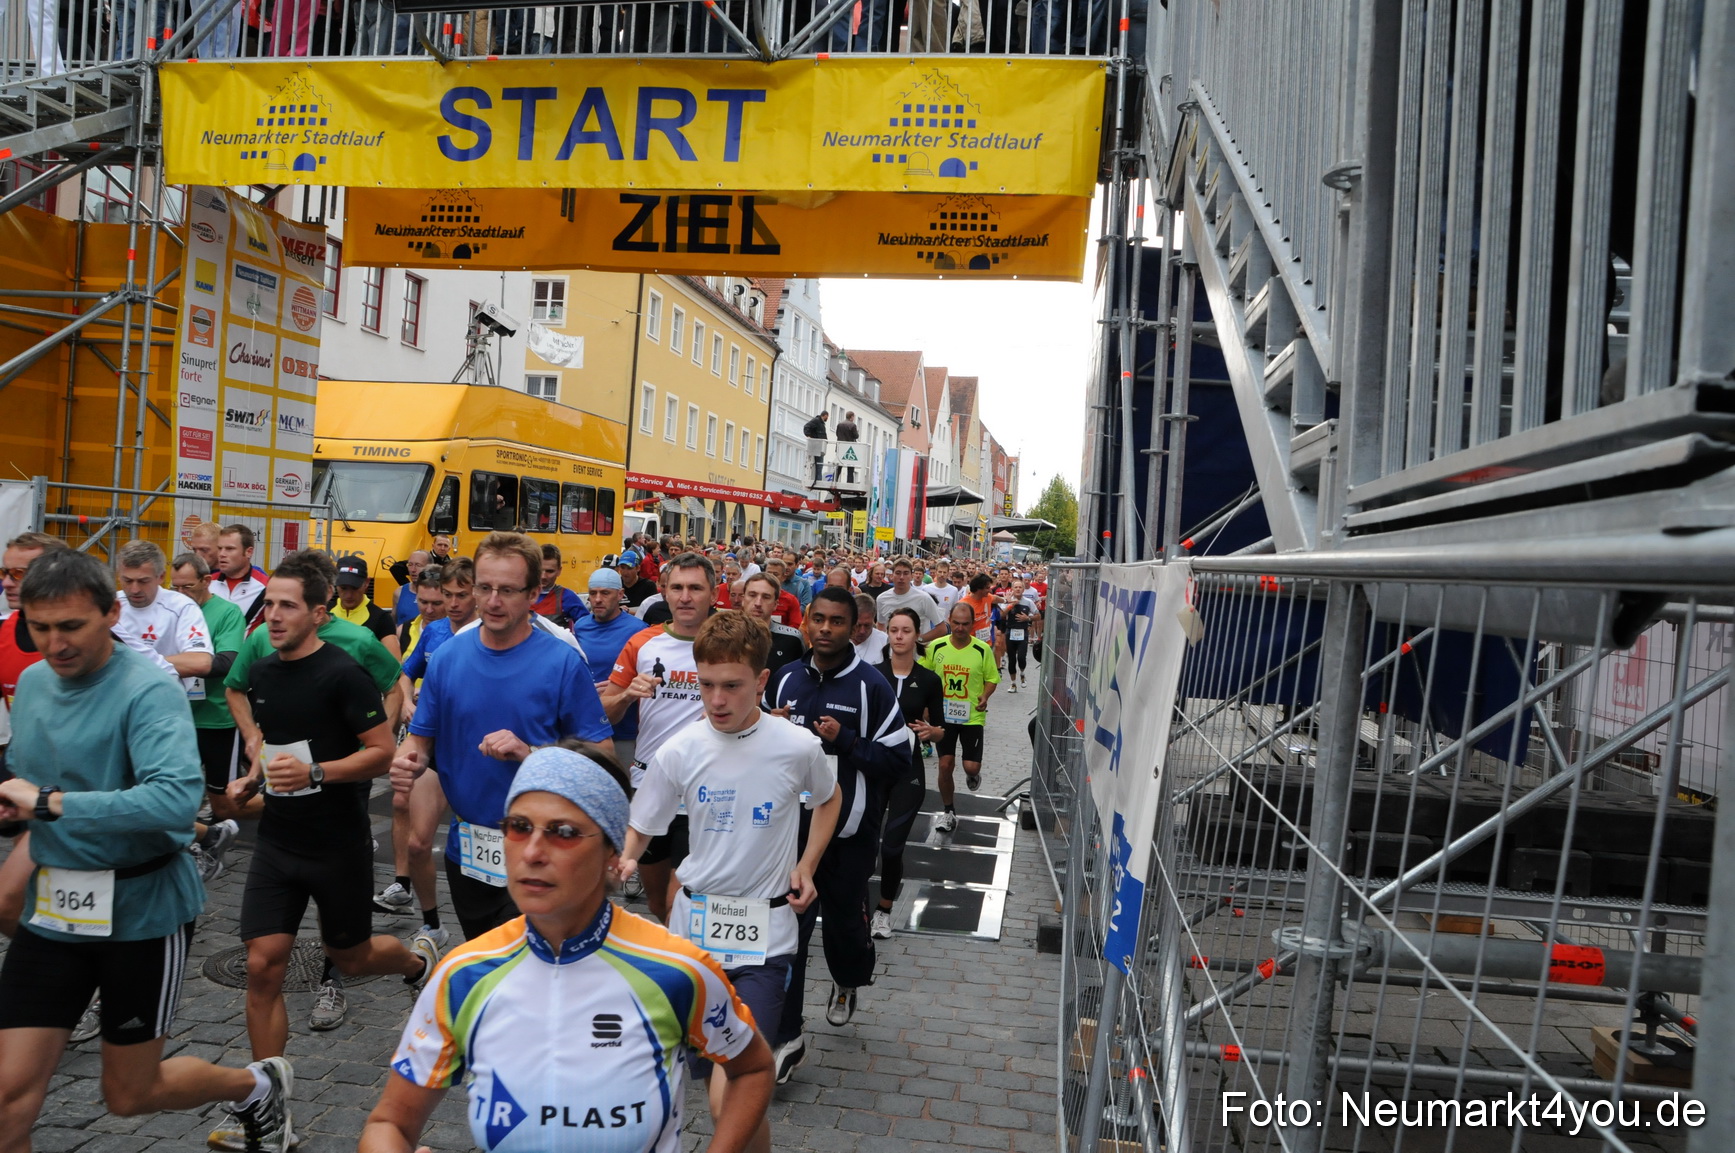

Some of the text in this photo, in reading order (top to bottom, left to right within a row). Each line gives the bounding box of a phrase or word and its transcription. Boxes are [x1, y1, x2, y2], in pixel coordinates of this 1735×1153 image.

[437, 86, 767, 163] START
[200, 128, 385, 147] Neumarkter Stadtlauf
[822, 130, 1043, 151] Neumarkter Stadtlauf
[612, 193, 781, 255] ZIEL
[374, 223, 526, 240] Neumarkter Stadtlauf
[877, 231, 1049, 248] Neumarkter Stadtlauf
[281, 236, 326, 261] MERZ
[291, 304, 317, 318] WITTMANN
[181, 351, 218, 371] Sinupret
[282, 356, 319, 379] OBI
[180, 368, 203, 382] forte
[279, 413, 305, 432] MCM
[182, 429, 193, 438] GUT
[193, 431, 202, 439] FÜR
[352, 445, 412, 458] TIMING
[496, 449, 528, 463] SPORTRONIC
[183, 472, 213, 482] INTERSPORT
[573, 464, 603, 478] EVENT SERVICE
[178, 480, 212, 492] HACKNER
[237, 482, 250, 490] MAX
[251, 482, 267, 491] BÖGL
[275, 477, 298, 486] GERHART
[640, 477, 664, 486] Service
[677, 482, 692, 491] Miet-
[699, 486, 732, 496] Serviceline:
[943, 664, 971, 672] Müller
[949, 678, 963, 692] M
[661, 691, 688, 701] TEAM
[948, 708, 967, 717] 2562
[698, 785, 711, 803] 6.
[473, 829, 505, 843] Norber
[55, 888, 97, 911] 964
[711, 902, 748, 918] Michael
[710, 922, 759, 942] 2783
[733, 954, 764, 962] PFLEIDERER
[591, 1041, 622, 1049] sportful
[540, 1100, 646, 1129] PLAST
